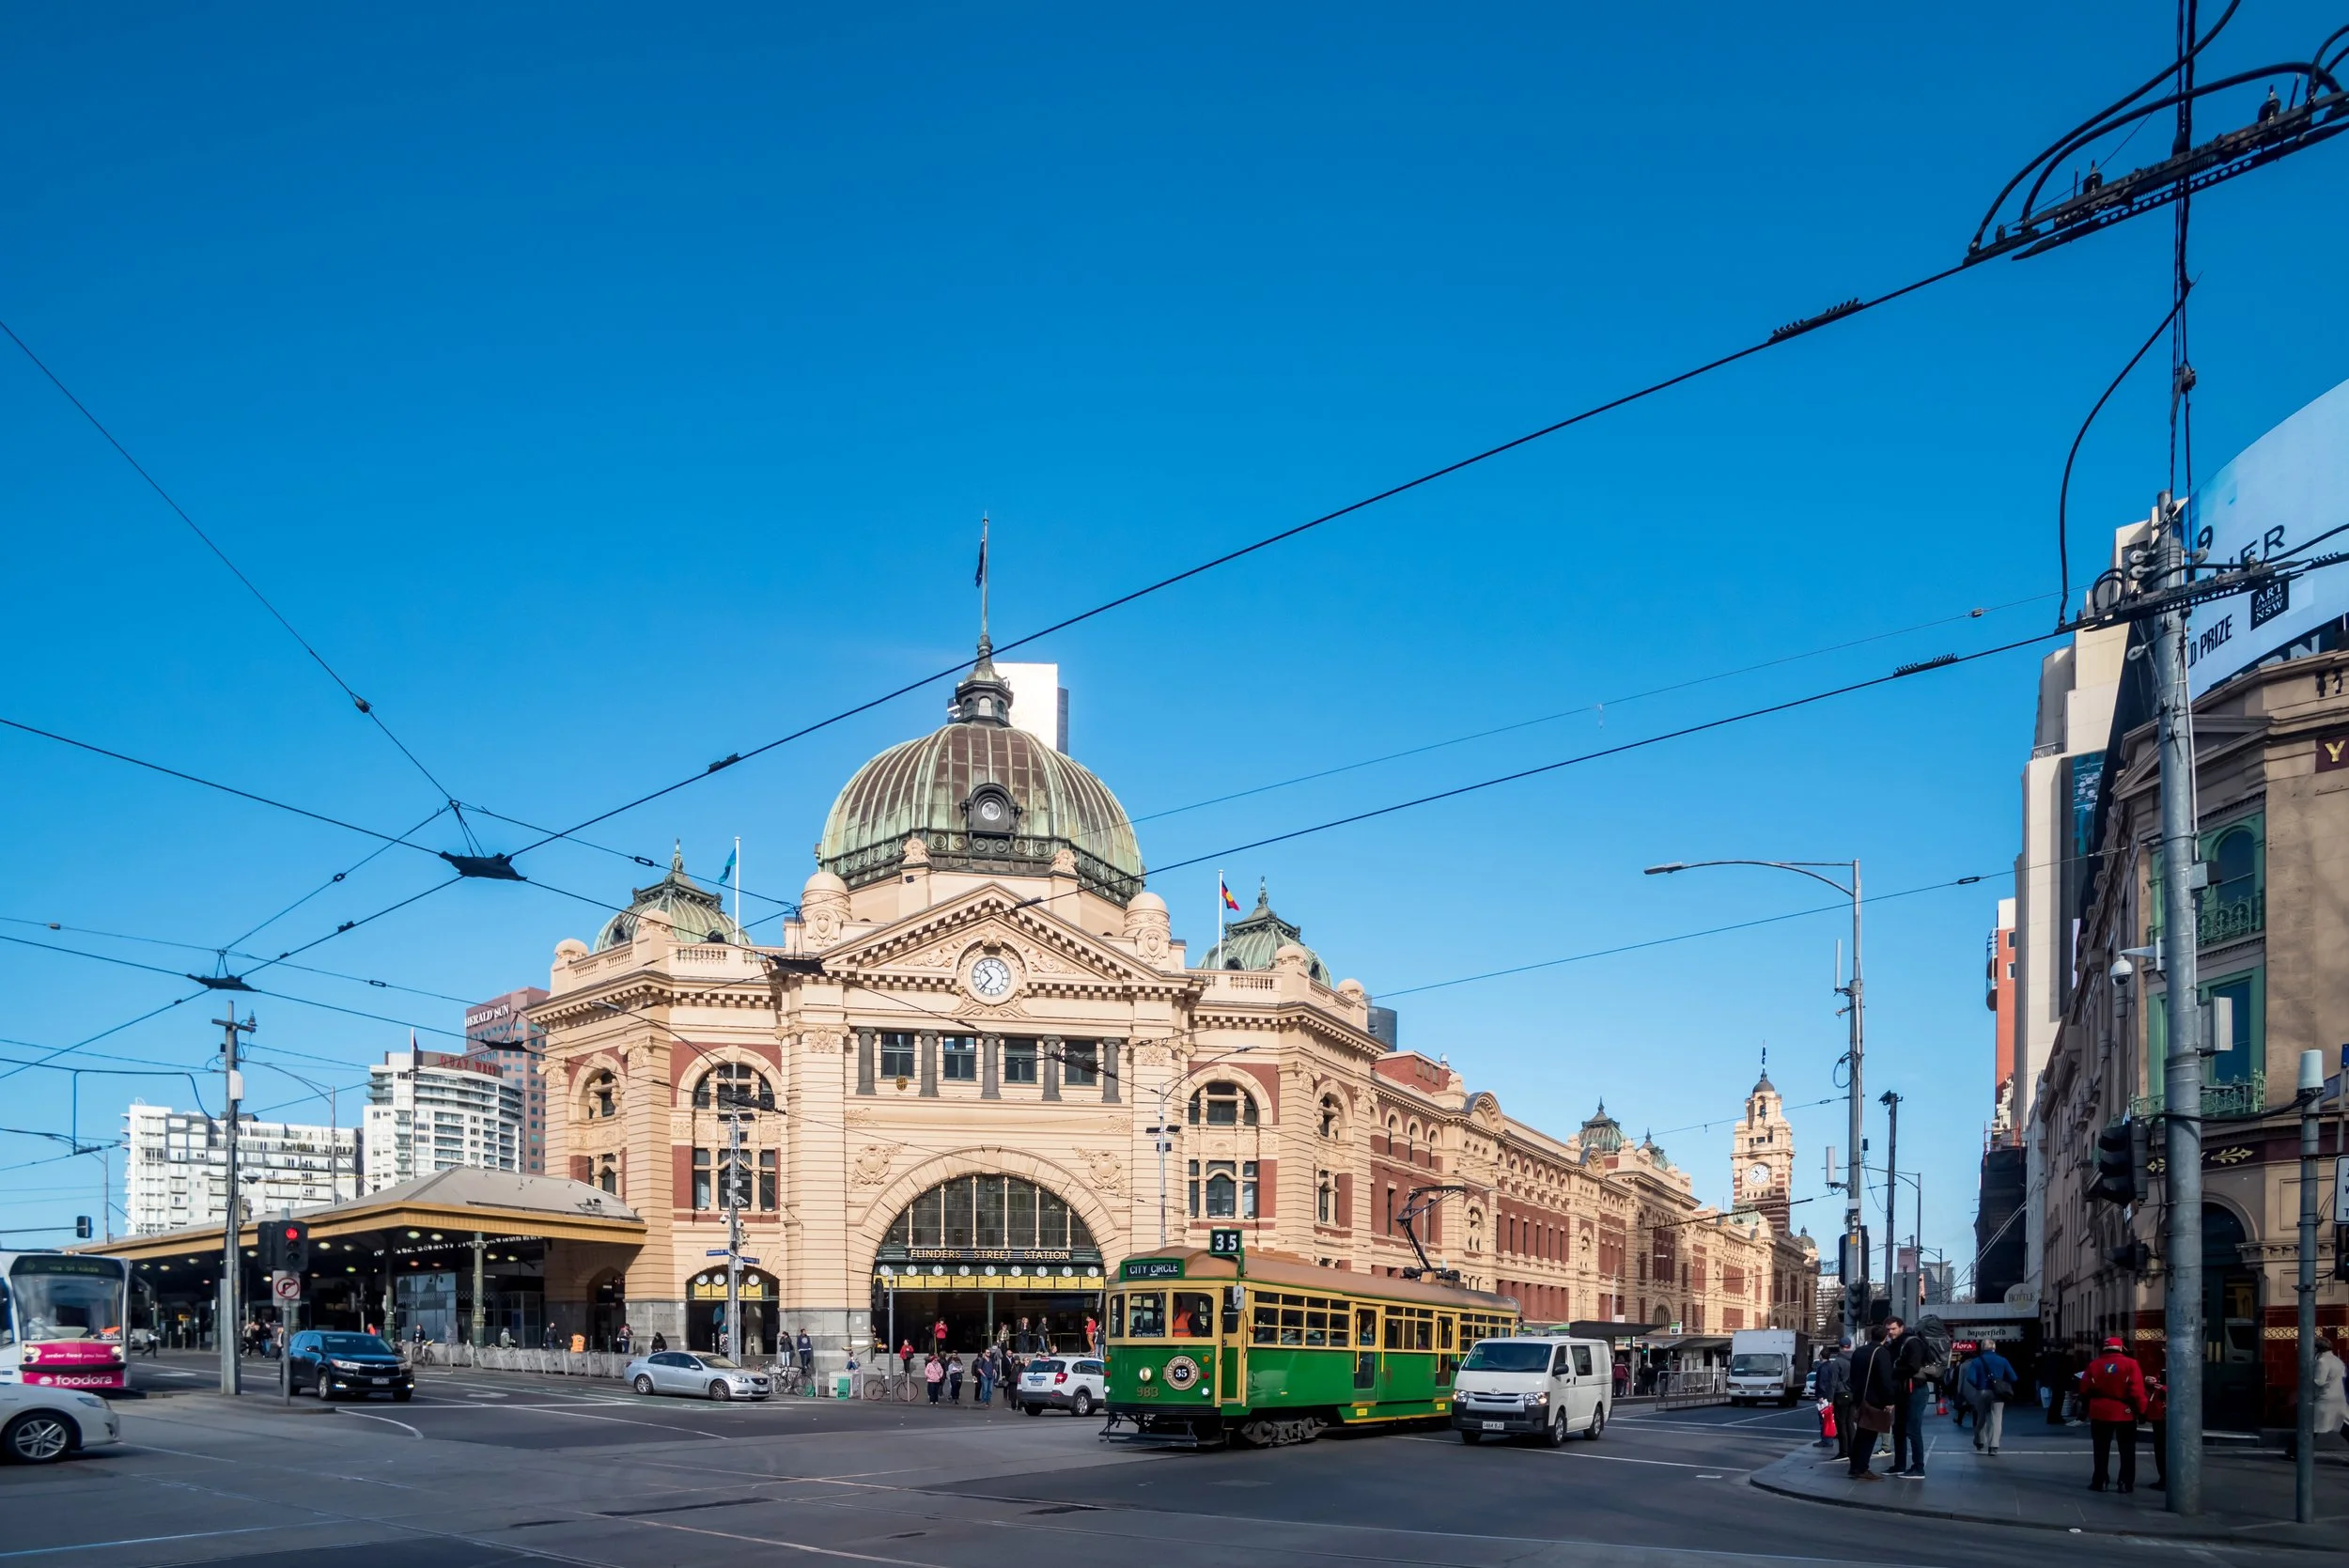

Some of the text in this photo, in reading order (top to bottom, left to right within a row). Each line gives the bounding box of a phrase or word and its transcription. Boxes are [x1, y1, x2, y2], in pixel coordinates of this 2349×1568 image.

[2256, 582, 2282, 606] ART
[2255, 593, 2284, 612] GALLERY
[2255, 598, 2284, 622] NSW
[2200, 613, 2233, 660] PRIZE
[464, 1003, 509, 1027] HERALD SUN
[440, 1055, 496, 1076] QUAY WEST
[1215, 1233, 1237, 1251] 35
[910, 1249, 1069, 1261] FLINDERS STREET STATION
[1129, 1264, 1178, 1275] CITY CIRCLE
[2008, 1293, 2035, 1302] BOTTLE
[1171, 1358, 1190, 1367] CIRCLE
[55, 1374, 113, 1386] foodora
[1175, 1369, 1188, 1378] 35
[1137, 1386, 1159, 1398] 983
